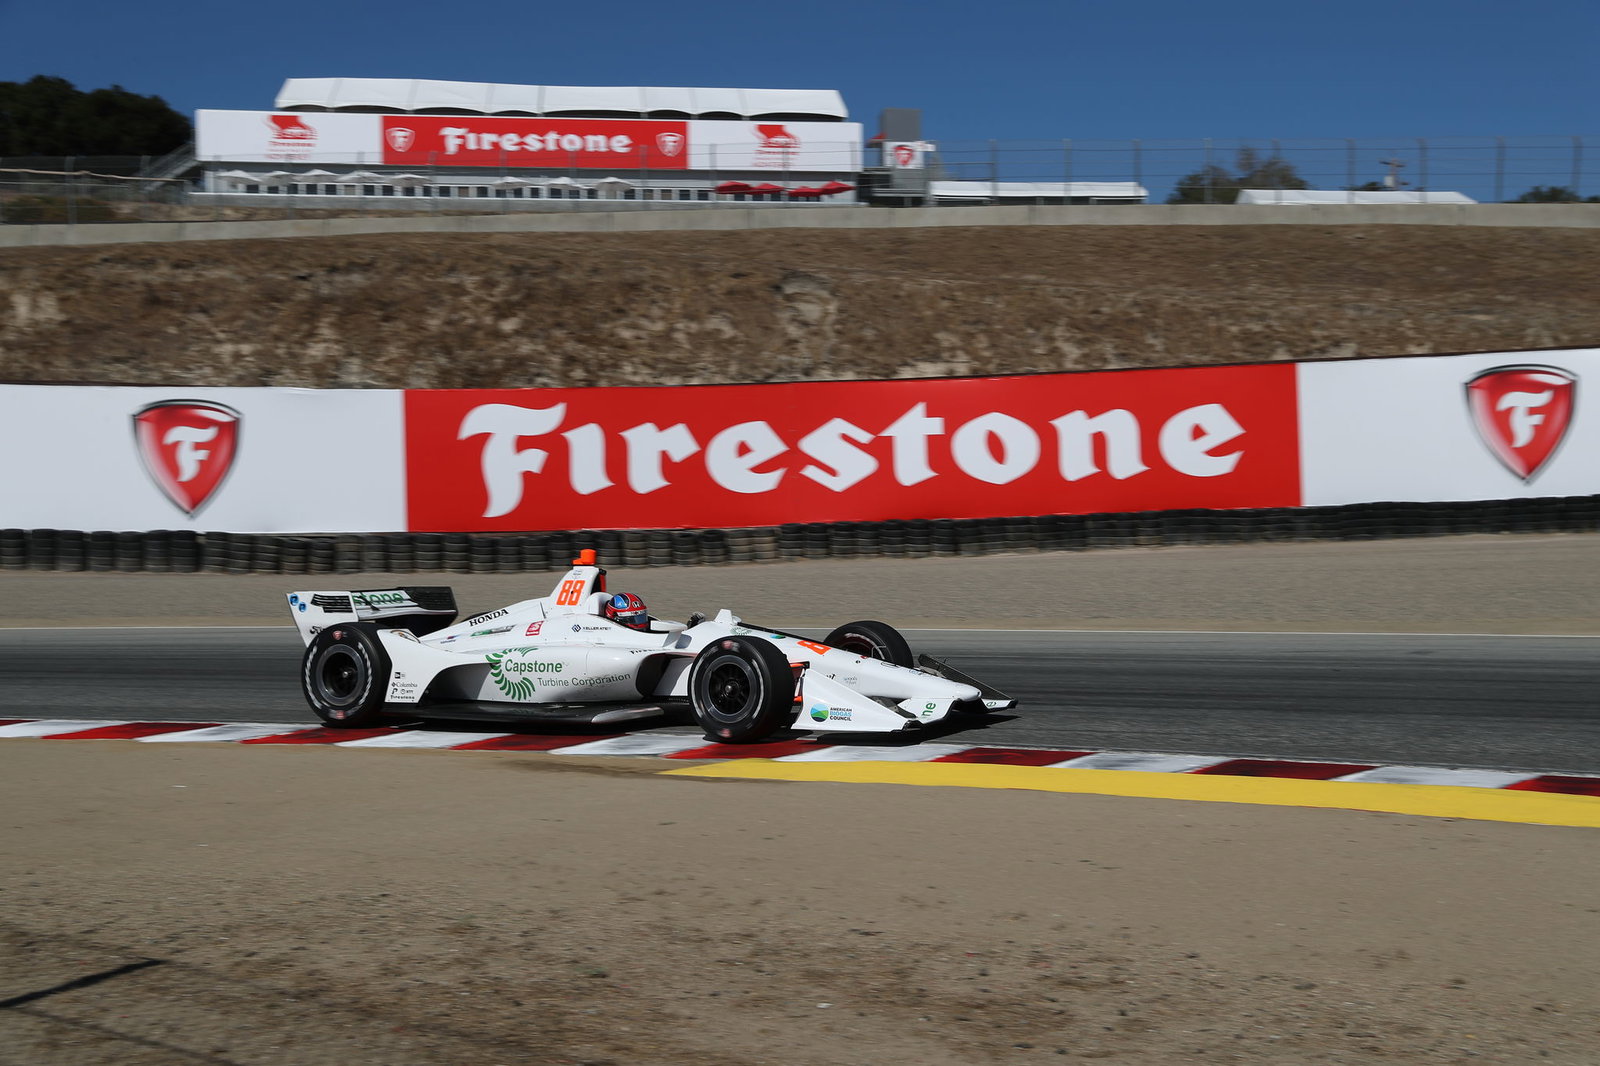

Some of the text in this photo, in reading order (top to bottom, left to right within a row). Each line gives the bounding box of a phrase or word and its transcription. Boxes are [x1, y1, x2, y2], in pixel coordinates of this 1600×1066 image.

[439, 126, 631, 155] Firestone
[457, 401, 1246, 518] Firestone
[556, 579, 585, 606] 88
[469, 608, 509, 627] HONDA
[505, 658, 563, 675] Capstone
[537, 673, 631, 687] Turbine Corporation
